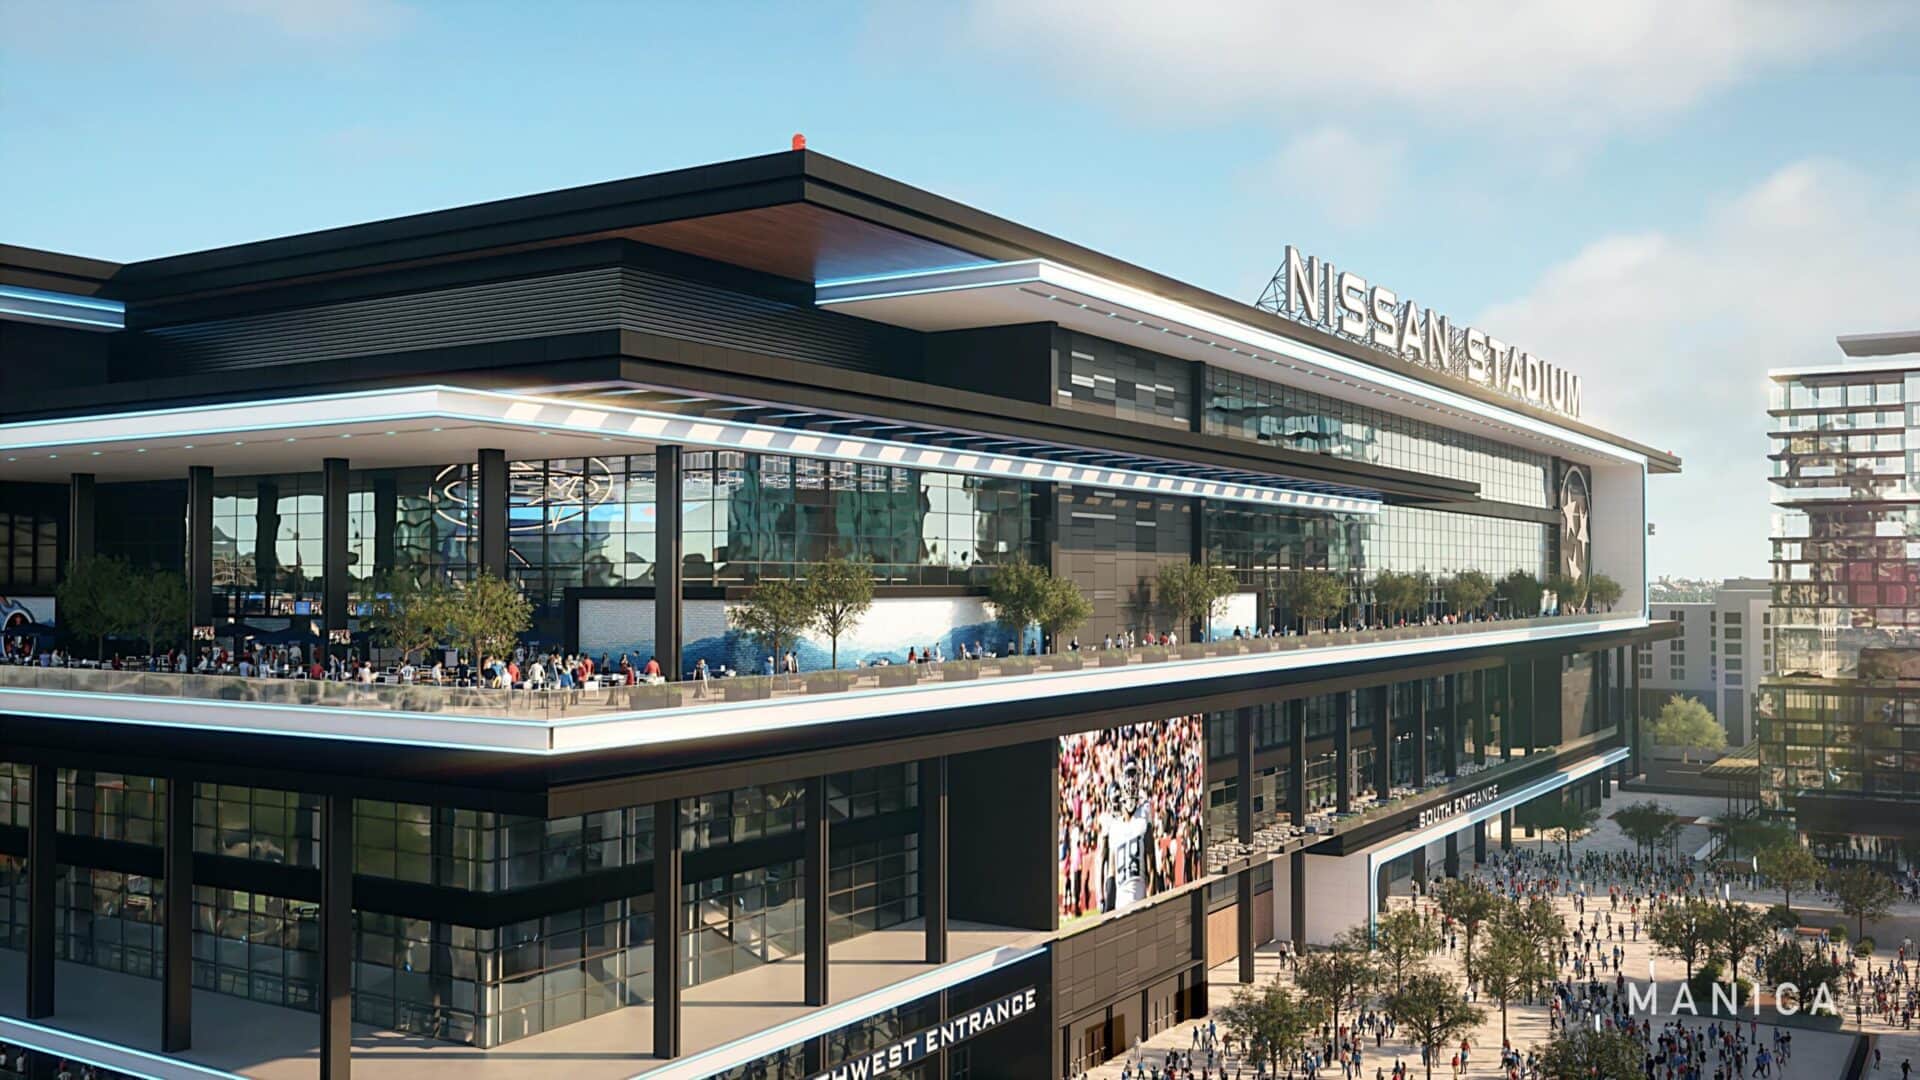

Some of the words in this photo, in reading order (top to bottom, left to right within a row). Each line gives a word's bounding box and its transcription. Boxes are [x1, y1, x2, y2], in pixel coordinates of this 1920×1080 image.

[1285, 245, 1450, 368] NISSAN
[1465, 327, 1582, 417] STADIUM
[1420, 801, 1452, 828] SOUTH
[1455, 784, 1499, 813] ENTRANCE
[925, 988, 1037, 1053] ENTRANCE
